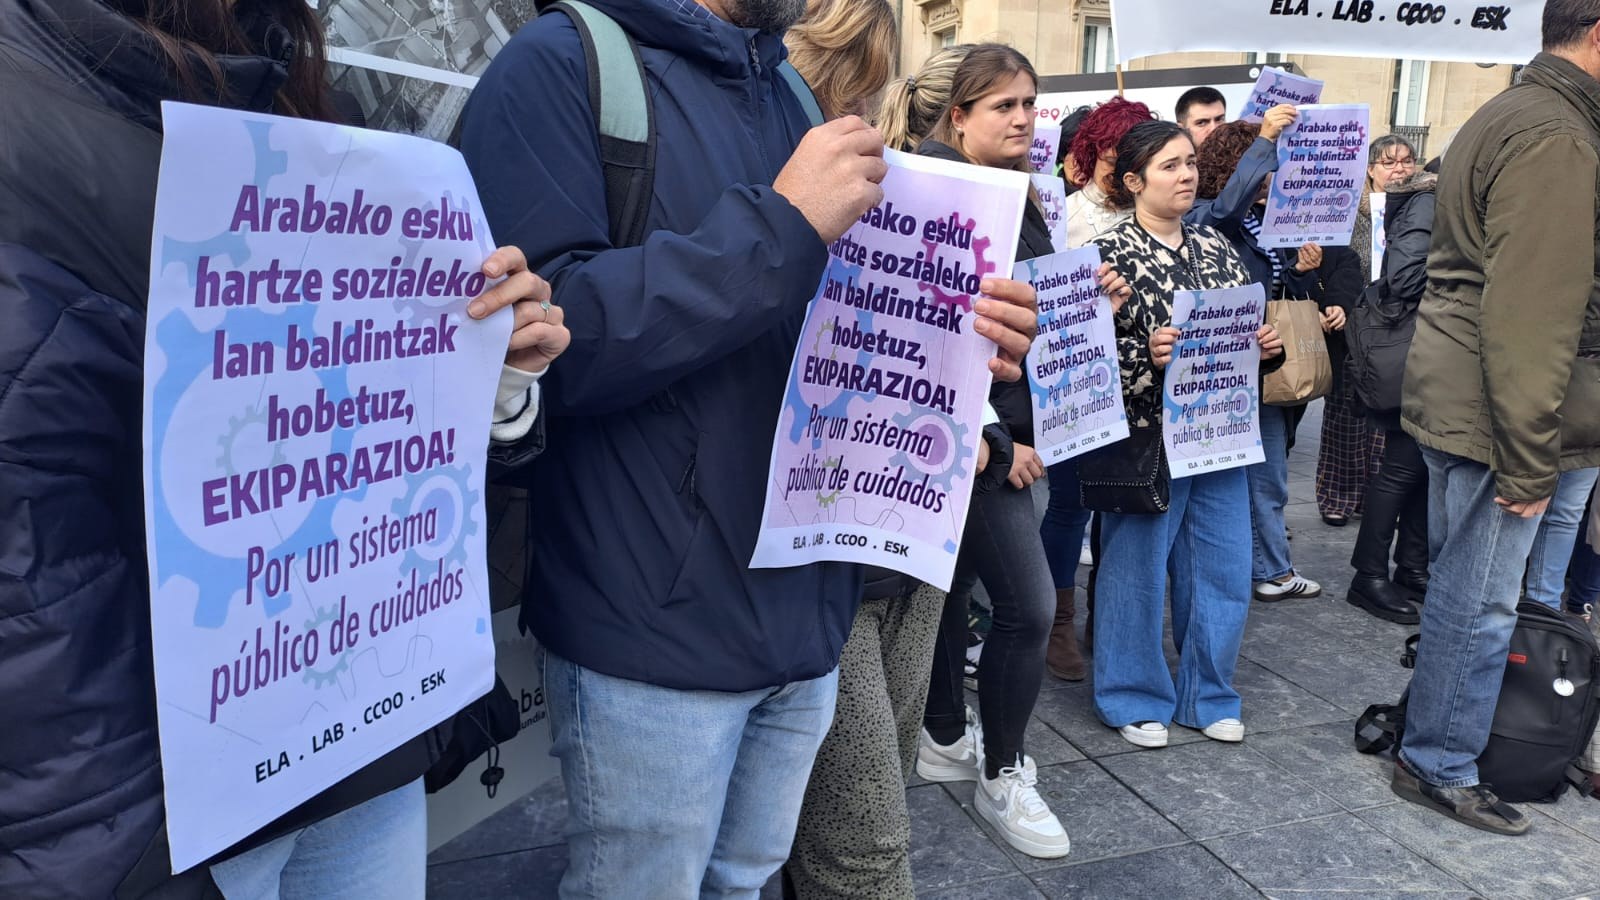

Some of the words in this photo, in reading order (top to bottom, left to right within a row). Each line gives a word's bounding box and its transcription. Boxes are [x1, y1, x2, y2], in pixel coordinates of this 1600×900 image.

[1270, 0, 1308, 15] ELA
[1332, 0, 1373, 22] LAB
[1397, 2, 1446, 25] CCOO
[1471, 6, 1511, 30] ESK
[1256, 95, 1279, 107] hart
[1267, 85, 1300, 101] Arabako
[1254, 107, 1265, 117] la
[1296, 123, 1337, 133] Arabako
[1339, 122, 1358, 132] esku
[1288, 137, 1319, 147] hartze
[1321, 136, 1362, 147] sozialeko
[1290, 152, 1305, 161] lan
[1307, 152, 1357, 161] baldintzak
[1301, 166, 1342, 176] hobetuz,
[1283, 179, 1354, 190] EKIPARAZIOA!
[229, 185, 392, 236] Arabako
[402, 198, 473, 241] esku
[1287, 195, 1300, 207] Por
[1302, 198, 1311, 206] un
[1313, 196, 1343, 206] sistema
[1274, 211, 1302, 226] público
[1304, 211, 1313, 223] de
[1315, 211, 1348, 223] cuidados
[923, 216, 971, 250] esku
[195, 257, 322, 307] hartze
[332, 256, 486, 301] sozialeko
[870, 249, 980, 295] sozialeko
[1070, 266, 1091, 283] esku
[823, 268, 843, 303] lan
[845, 276, 963, 334] baldintzak
[1057, 286, 1099, 308] sozialeko
[1037, 323, 1048, 335] an
[1049, 305, 1098, 332] baldintzak
[1188, 305, 1233, 321] Arabako
[1235, 302, 1257, 316] esku
[1213, 320, 1259, 336] sozialeko
[212, 330, 273, 380] lan
[286, 314, 457, 371] baldintzak
[831, 316, 926, 369] hobetuz,
[1048, 333, 1088, 354] hobetuz,
[1179, 346, 1195, 358] lan
[1198, 339, 1251, 359] baldintzak
[1037, 345, 1105, 379] EKIPARAZIOA!
[1191, 361, 1234, 375] hobetuz,
[803, 356, 956, 415] EKIPARAZIOA!
[1048, 385, 1061, 402] Por
[1063, 384, 1072, 398] un
[1074, 373, 1101, 394] sistema
[1173, 374, 1248, 396] EKIPARAZIOA!
[267, 386, 415, 442] hobetuz,
[1042, 407, 1068, 436] público
[1071, 402, 1079, 421] de
[1081, 392, 1114, 416] cuidados
[1182, 403, 1195, 419] Por
[1198, 405, 1208, 416] un
[1211, 400, 1241, 415] sistema
[807, 403, 828, 438] Por
[828, 417, 848, 441] un
[850, 415, 933, 458] sistema
[1173, 425, 1202, 448] público
[1205, 421, 1214, 439] de
[1216, 418, 1251, 438] cuidados
[1067, 442, 1077, 452] LAB
[202, 428, 456, 526] EKIPARAZIOA!
[785, 453, 825, 500] público
[828, 456, 849, 490] de
[853, 469, 946, 513] cuidados
[246, 546, 294, 604] Por
[306, 537, 339, 583] un
[350, 507, 437, 568] sistema
[793, 536, 806, 549] ELA
[812, 533, 824, 546] LAB
[835, 533, 868, 547] CCOO
[884, 540, 910, 557] ESK
[210, 625, 319, 723] público
[330, 596, 360, 654] de
[369, 558, 464, 635] cuidados
[255, 751, 290, 783] ELA
[312, 723, 344, 753] LAB
[364, 692, 404, 724] CCOO
[421, 669, 446, 695] ESK
